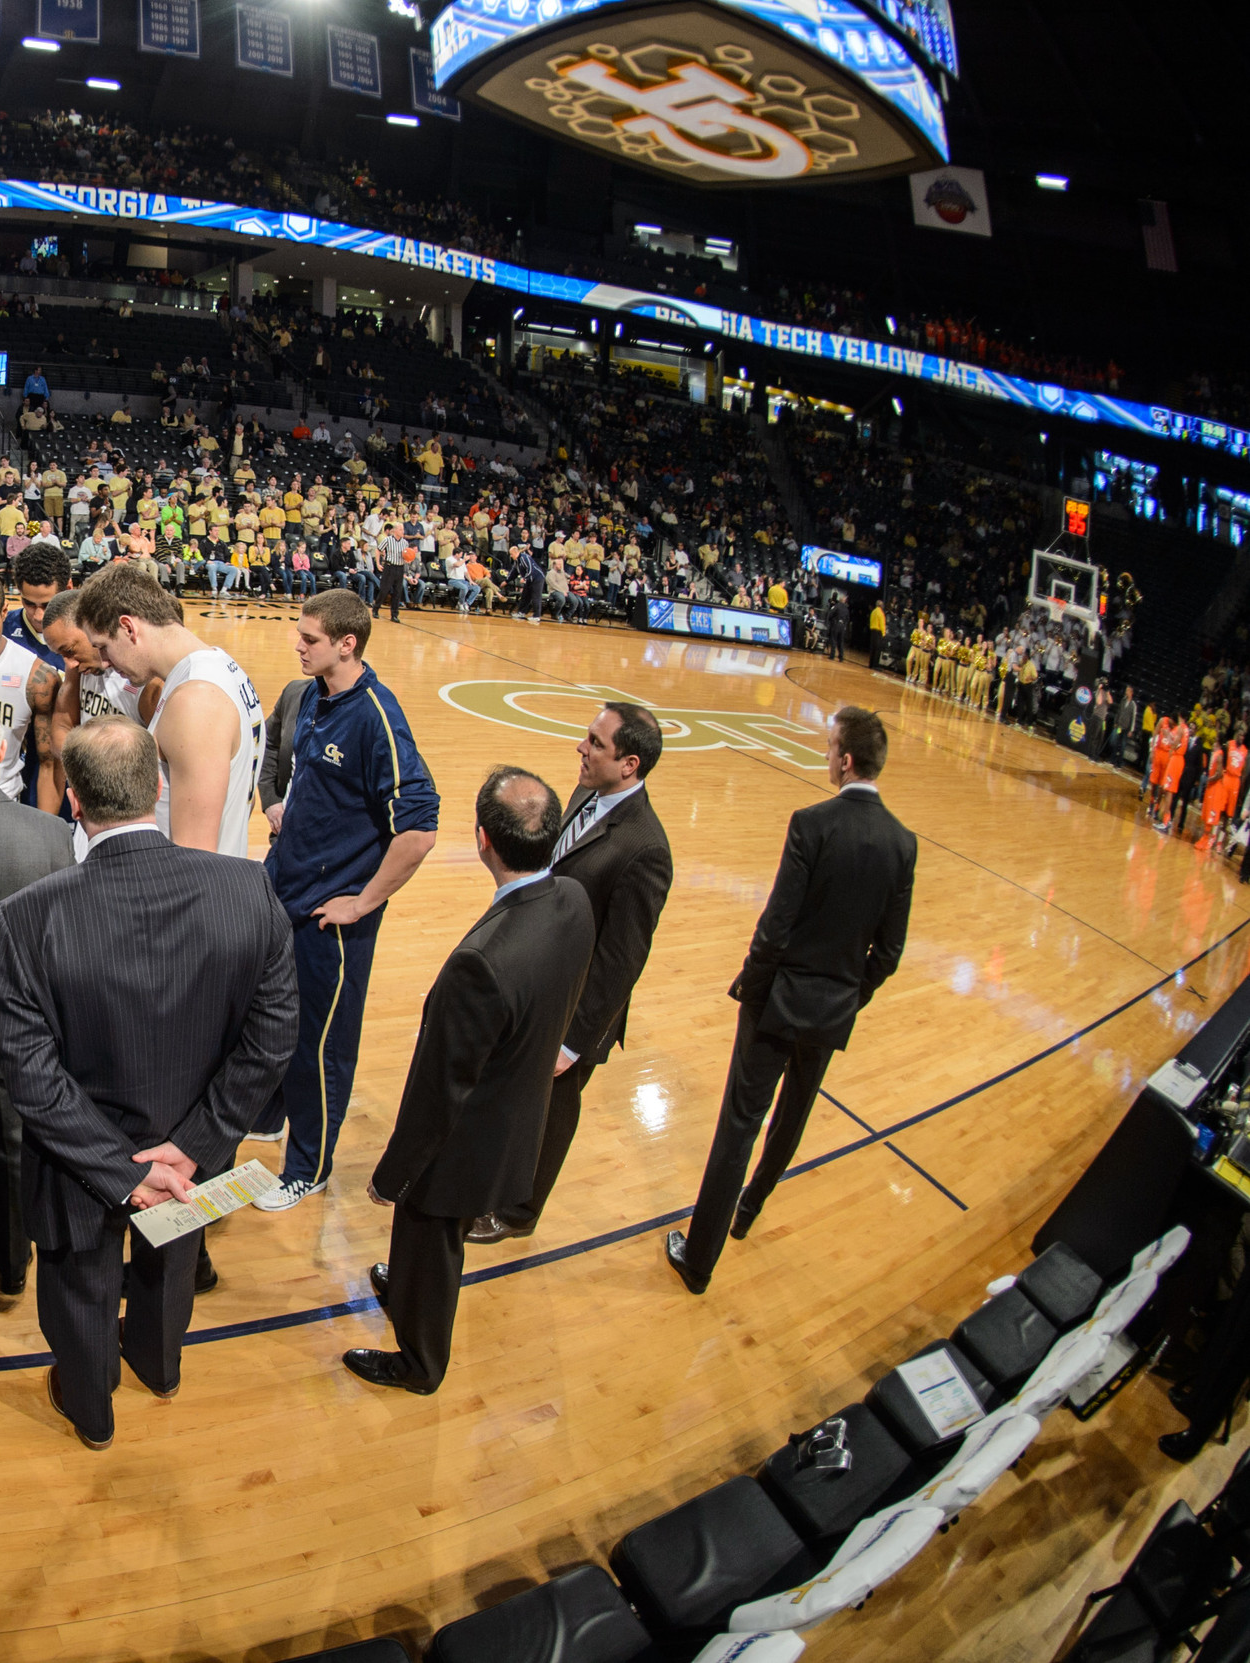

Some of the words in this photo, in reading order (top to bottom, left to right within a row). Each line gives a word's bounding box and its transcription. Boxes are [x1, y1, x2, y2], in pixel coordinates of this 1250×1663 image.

[387, 235, 496, 285] JACKETS
[760, 320, 823, 357] TECH
[829, 333, 925, 379] YELLOW
[325, 743, 345, 763] GT
